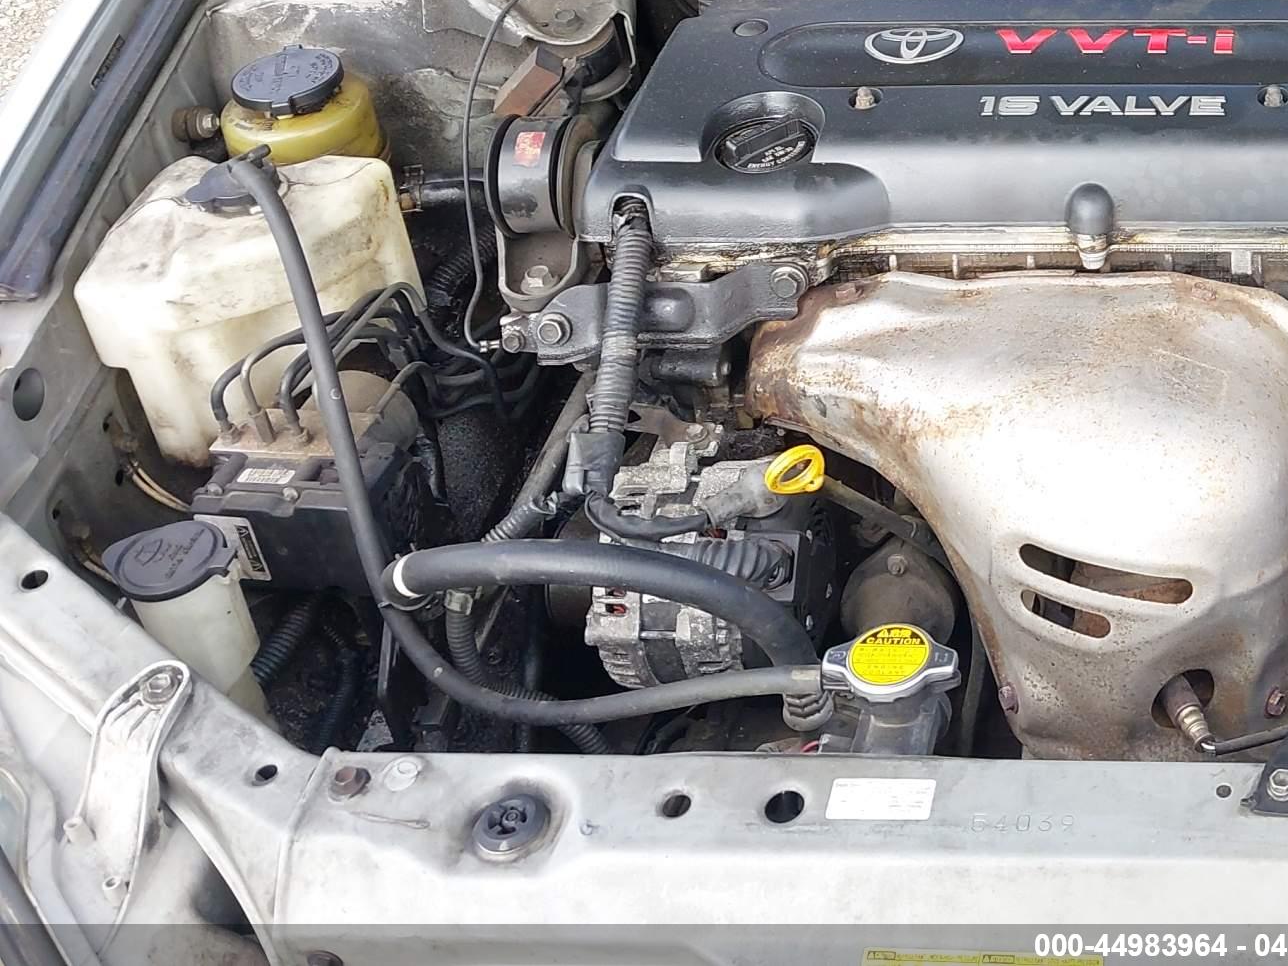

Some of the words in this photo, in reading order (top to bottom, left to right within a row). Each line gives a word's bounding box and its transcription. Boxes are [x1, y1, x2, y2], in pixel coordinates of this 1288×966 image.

[980, 95, 1041, 116] 16
[1051, 95, 1227, 116] VALVE
[866, 637, 921, 645] CAUTION
